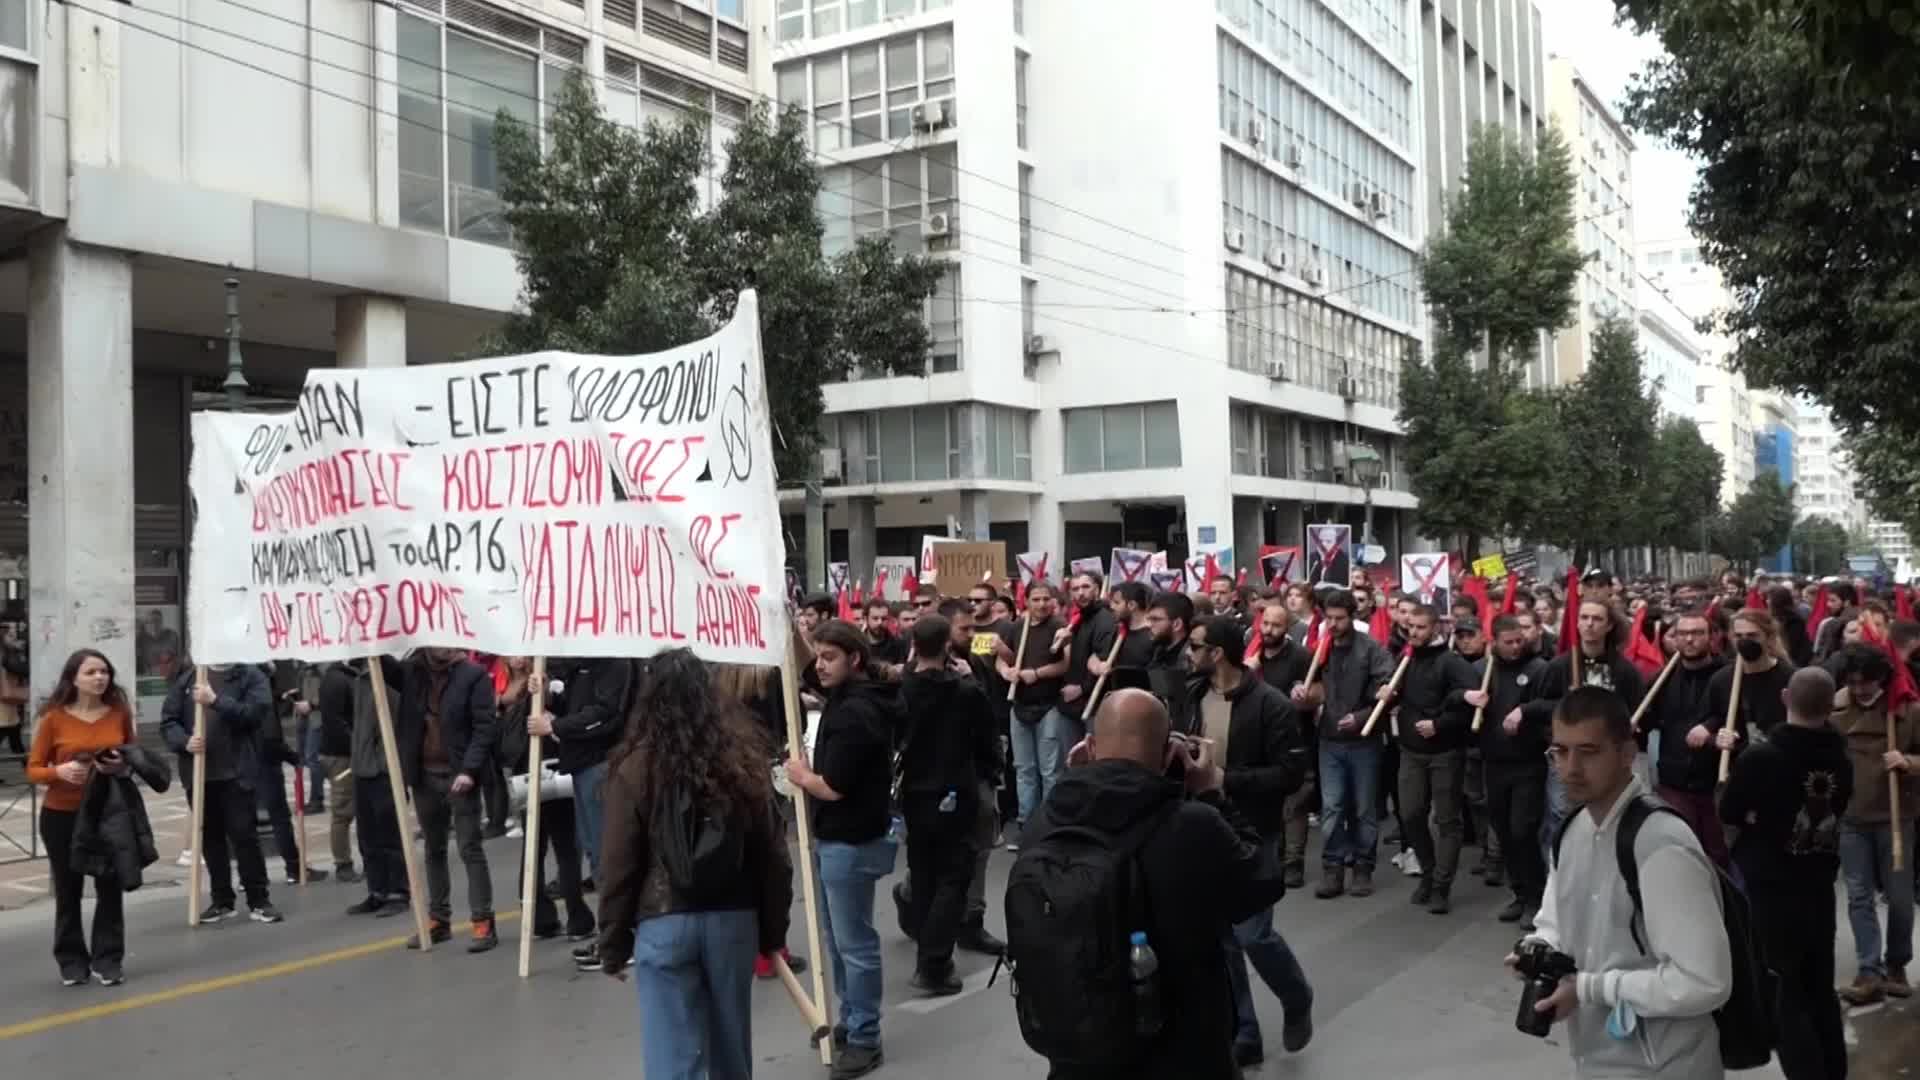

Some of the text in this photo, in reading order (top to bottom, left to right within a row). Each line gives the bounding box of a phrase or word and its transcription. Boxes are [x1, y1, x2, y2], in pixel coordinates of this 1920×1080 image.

[447, 363, 551, 438] ΕΙΣΤΕ
[443, 439, 602, 513] ΚΟΣΤΙΖΟΥΝ
[696, 581, 767, 649] ΑΘΗΝΑΣ
